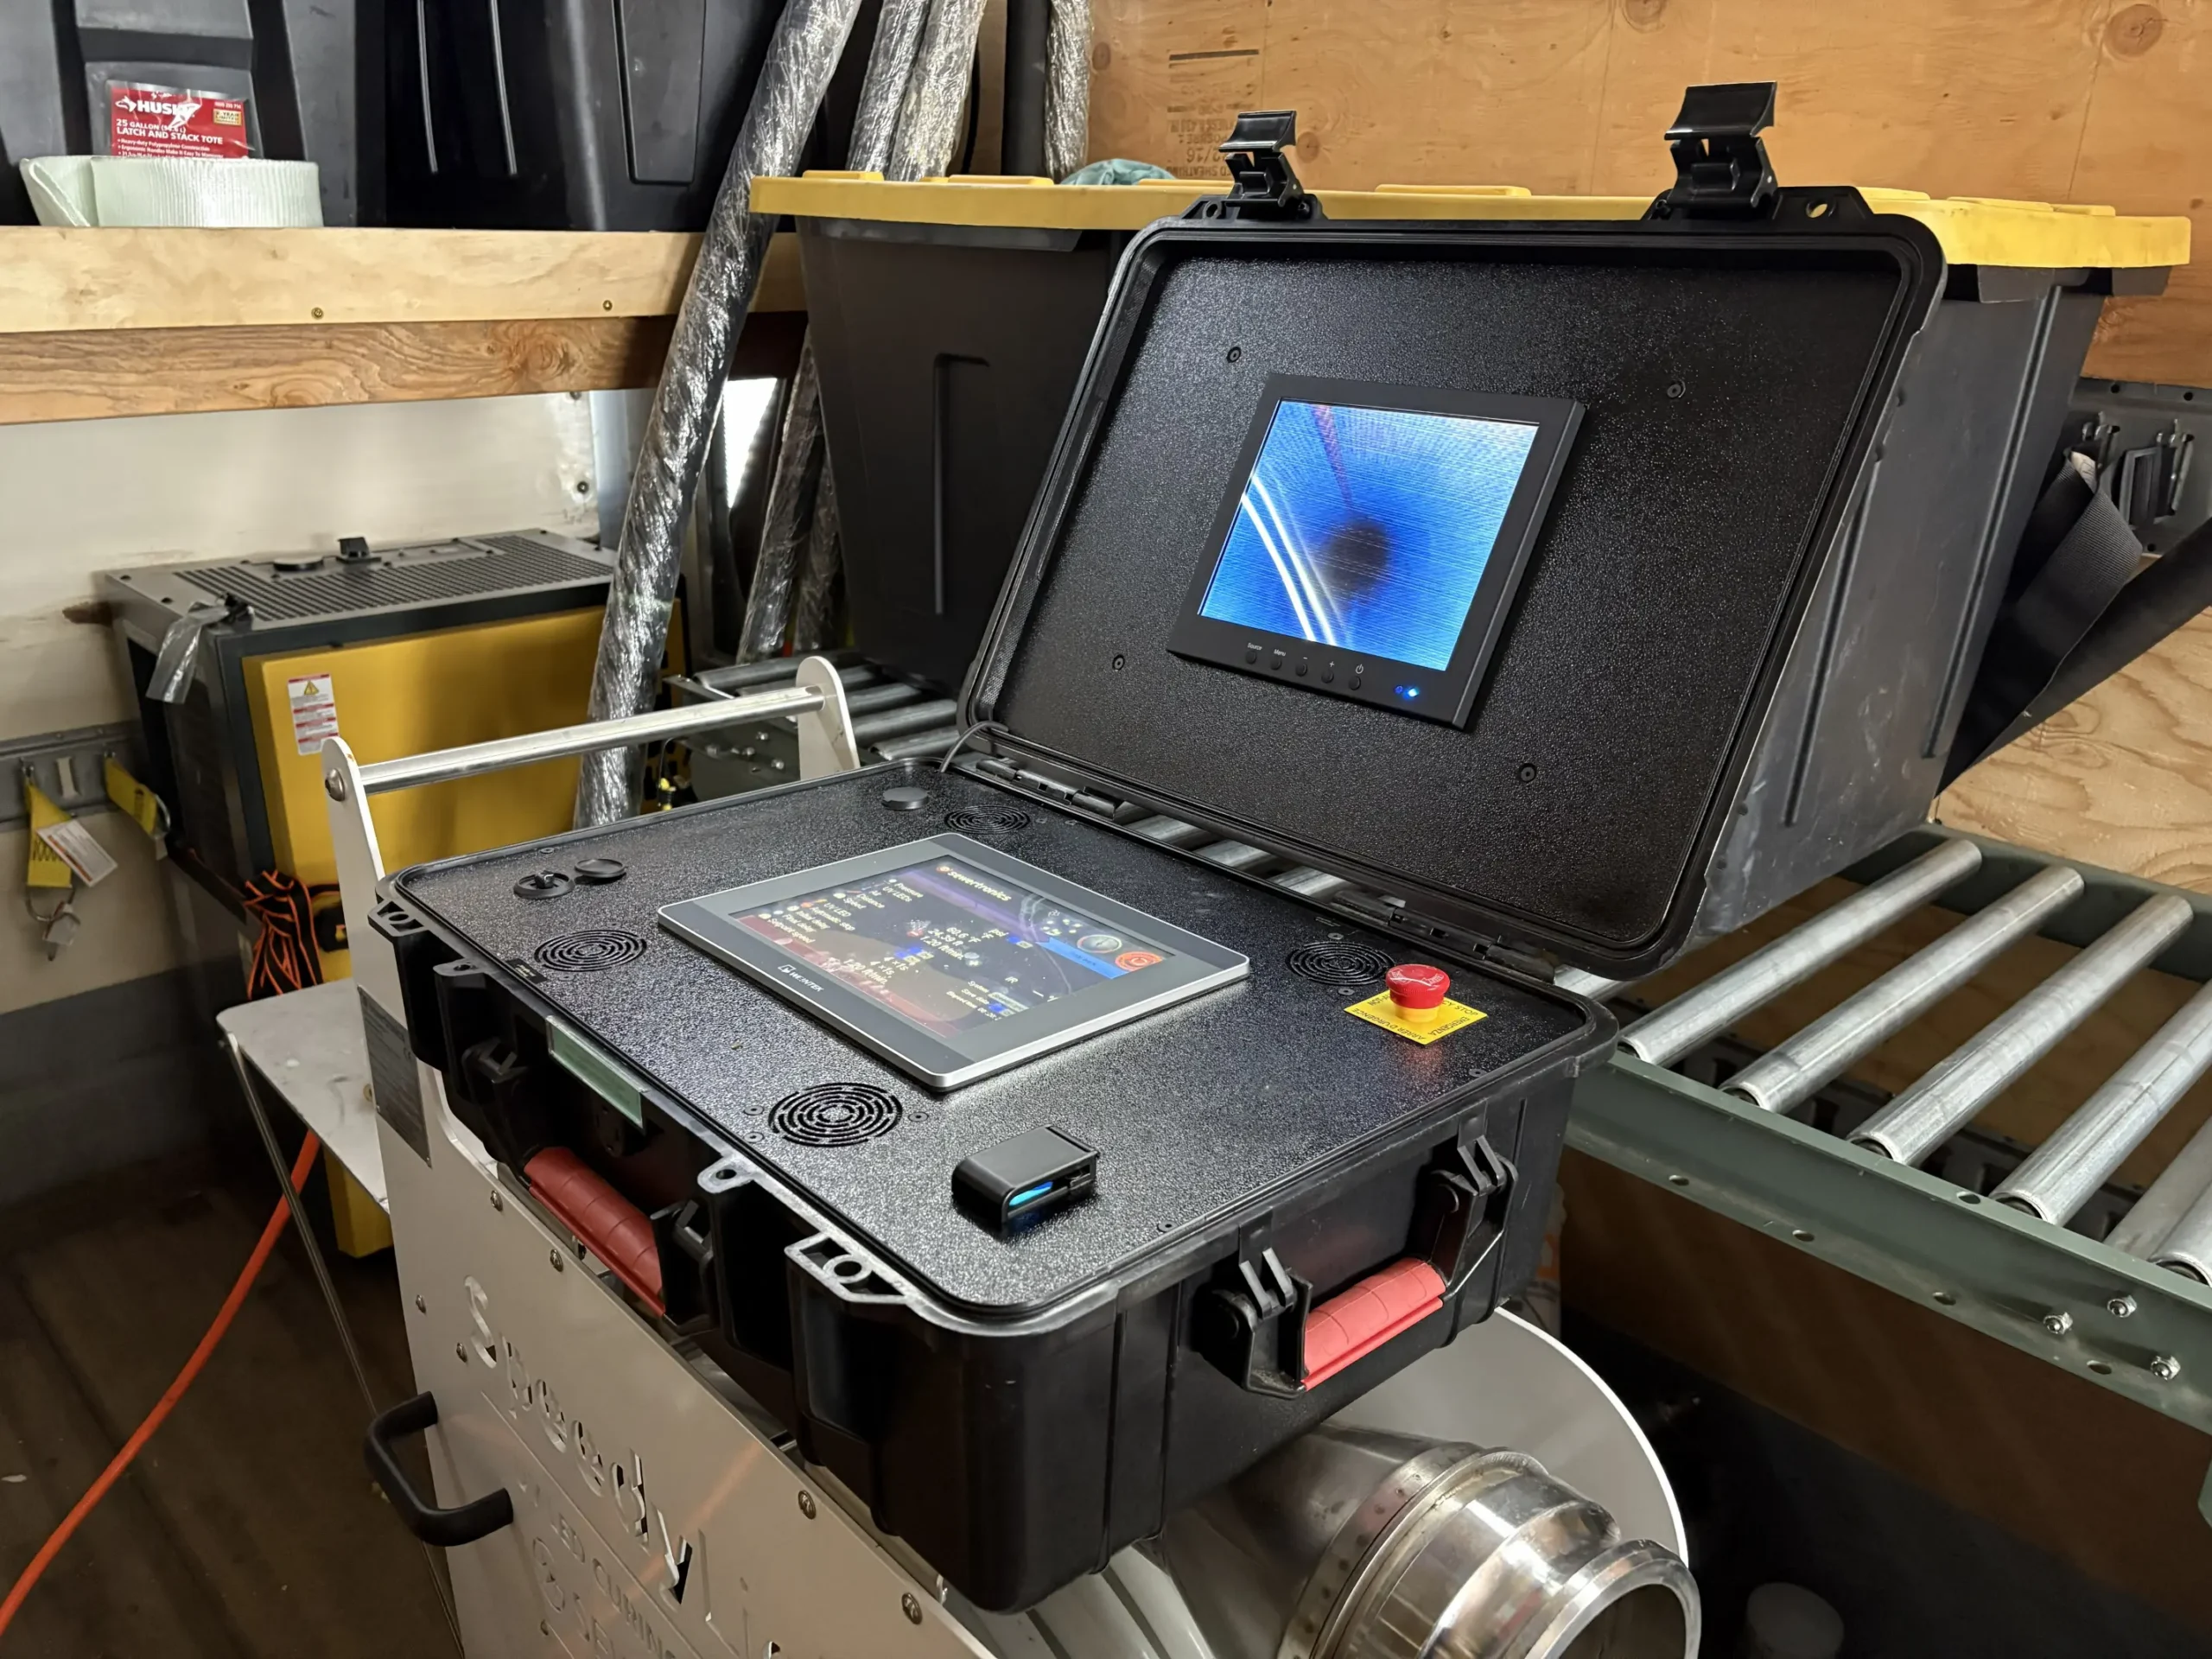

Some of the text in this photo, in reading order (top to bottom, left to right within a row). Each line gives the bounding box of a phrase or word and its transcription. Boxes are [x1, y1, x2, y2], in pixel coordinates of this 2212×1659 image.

[116, 118, 128, 127] 25
[130, 121, 159, 130] GALLON
[116, 126, 223, 145] LATCH AND STACK TOTE
[947, 871, 1014, 901] sewertronics
[946, 927, 969, 938] 60.6
[1453, 1004, 1478, 1017] STOP
